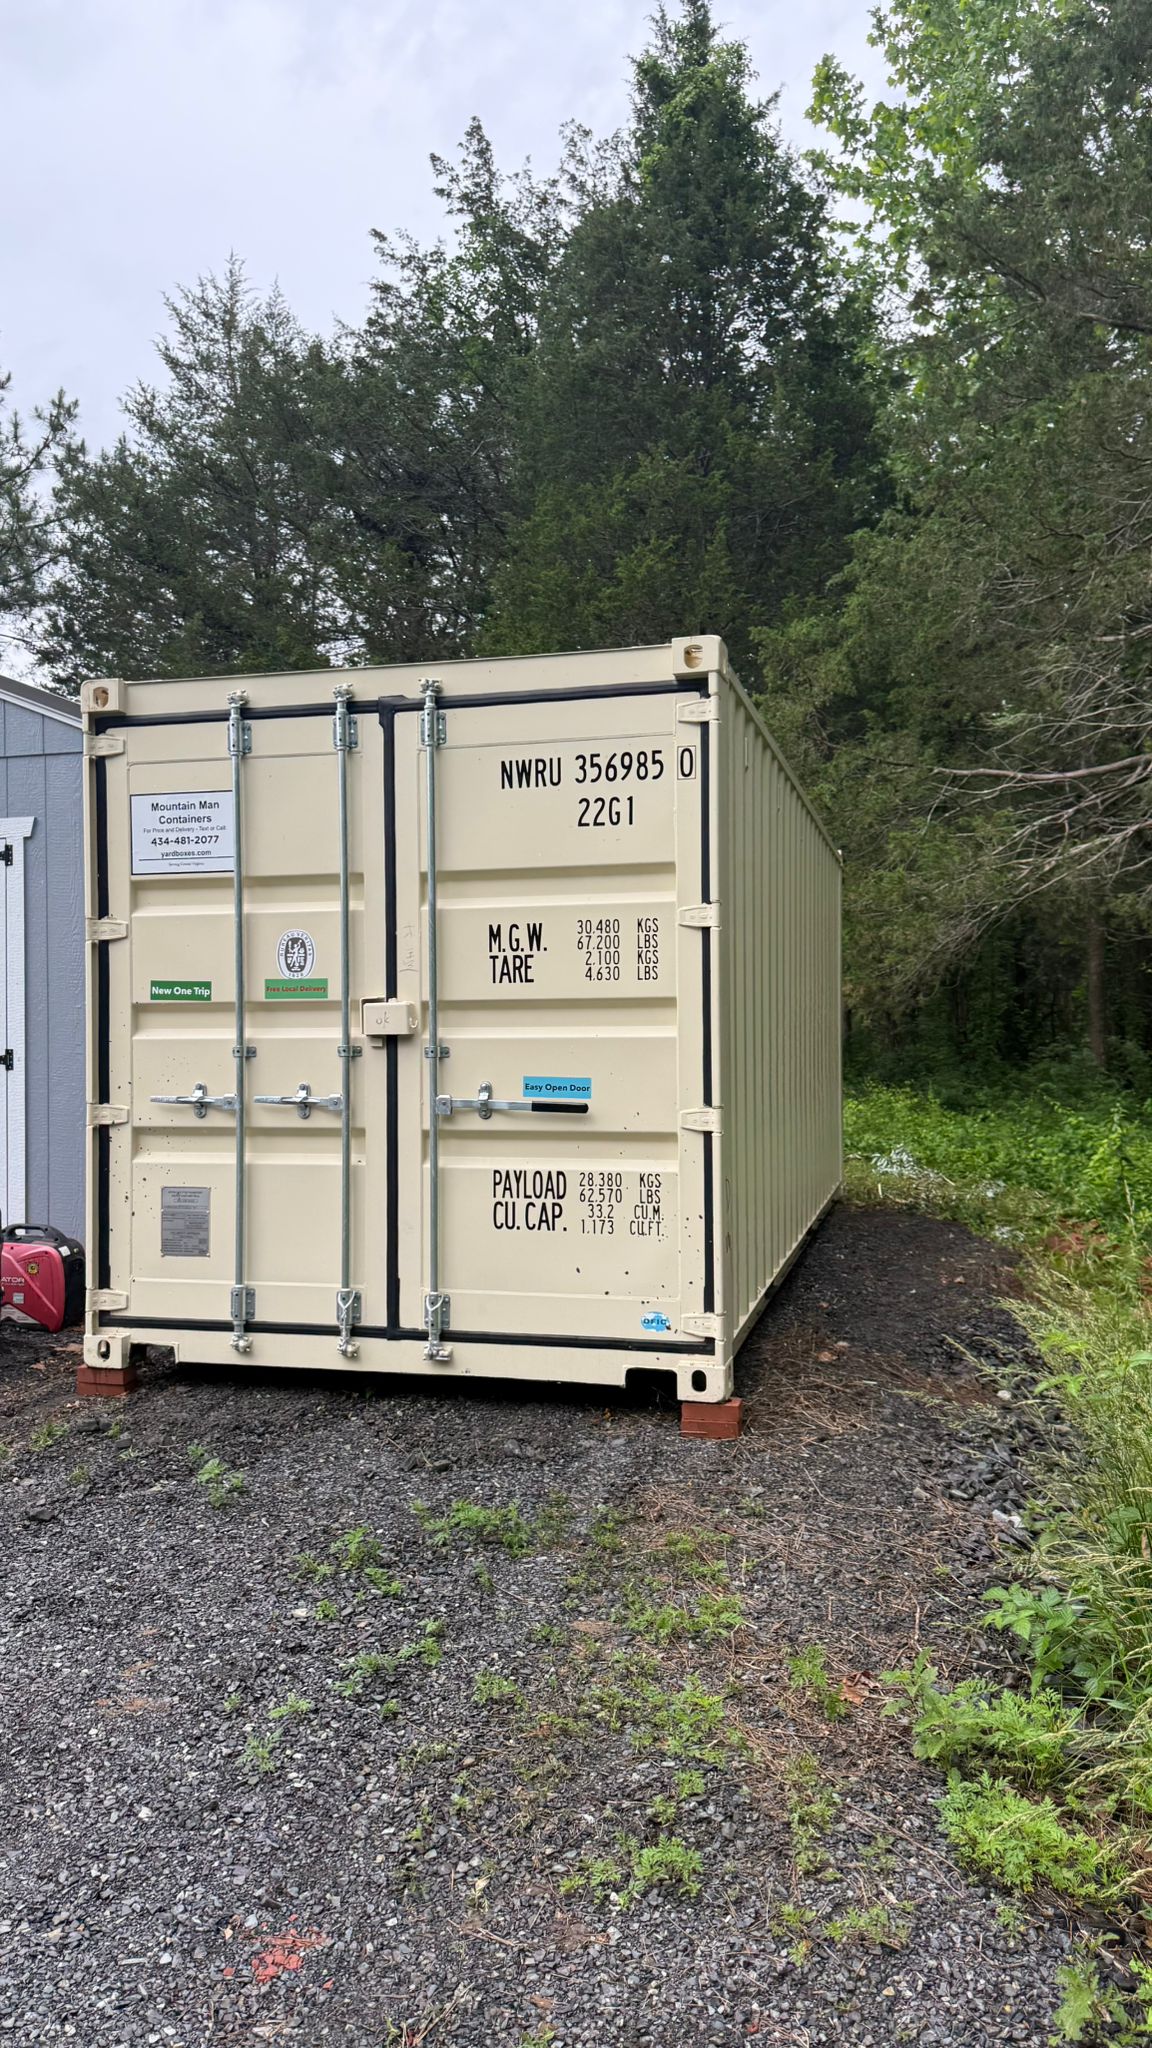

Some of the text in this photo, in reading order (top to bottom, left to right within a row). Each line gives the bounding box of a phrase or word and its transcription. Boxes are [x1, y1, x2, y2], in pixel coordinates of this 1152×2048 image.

[501, 747, 694, 790] NWRU 356985 0
[151, 800, 220, 812] Mountain Man
[577, 796, 634, 827] 22G1
[158, 814, 212, 825] Containers
[175, 825, 195, 833] Delivery
[150, 835, 220, 847] 434-481-2077
[160, 850, 212, 859] yardboxes.com
[636, 917, 659, 934] KGS
[488, 922, 548, 953] M.G.W.
[636, 933, 659, 949] LBS
[636, 949, 659, 965] KGS
[489, 954, 534, 984] TARE
[636, 965, 659, 981] LBS
[152, 986, 211, 998] New One Trip
[265, 985, 280, 993] Free
[300, 985, 326, 994] Delivery
[525, 1083, 591, 1093] Easy Open Door
[493, 1169, 568, 1200] PAYLOAD
[579, 1172, 662, 1188] 28.380 KGS
[579, 1188, 661, 1204] 62.570 LBS
[587, 1204, 614, 1219] 33.2
